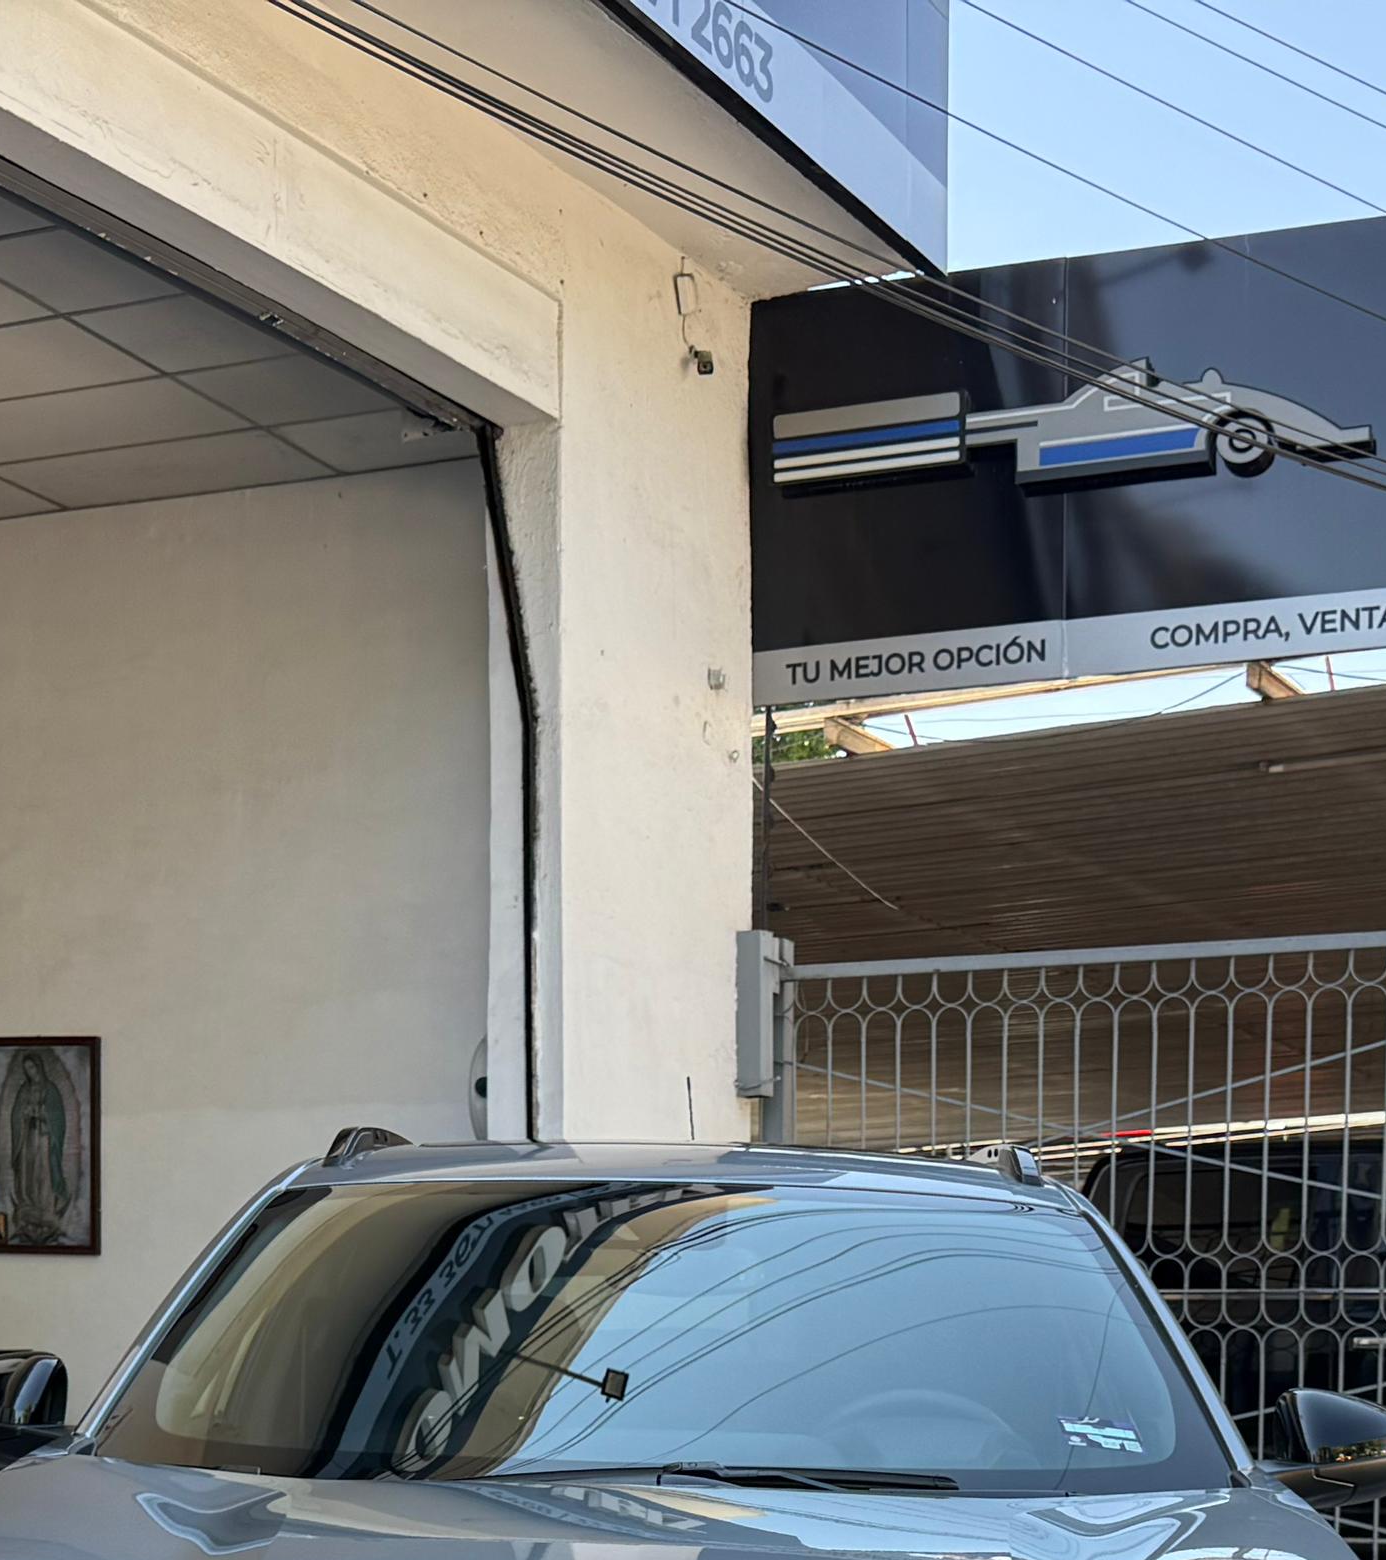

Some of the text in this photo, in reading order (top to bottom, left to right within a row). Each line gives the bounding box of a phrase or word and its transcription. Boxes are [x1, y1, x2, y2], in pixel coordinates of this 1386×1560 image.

[691, 0, 773, 103] 2663
[1150, 613, 1292, 651] COMPRA,
[785, 636, 1046, 686] TU MEJOR OPCIÓN
